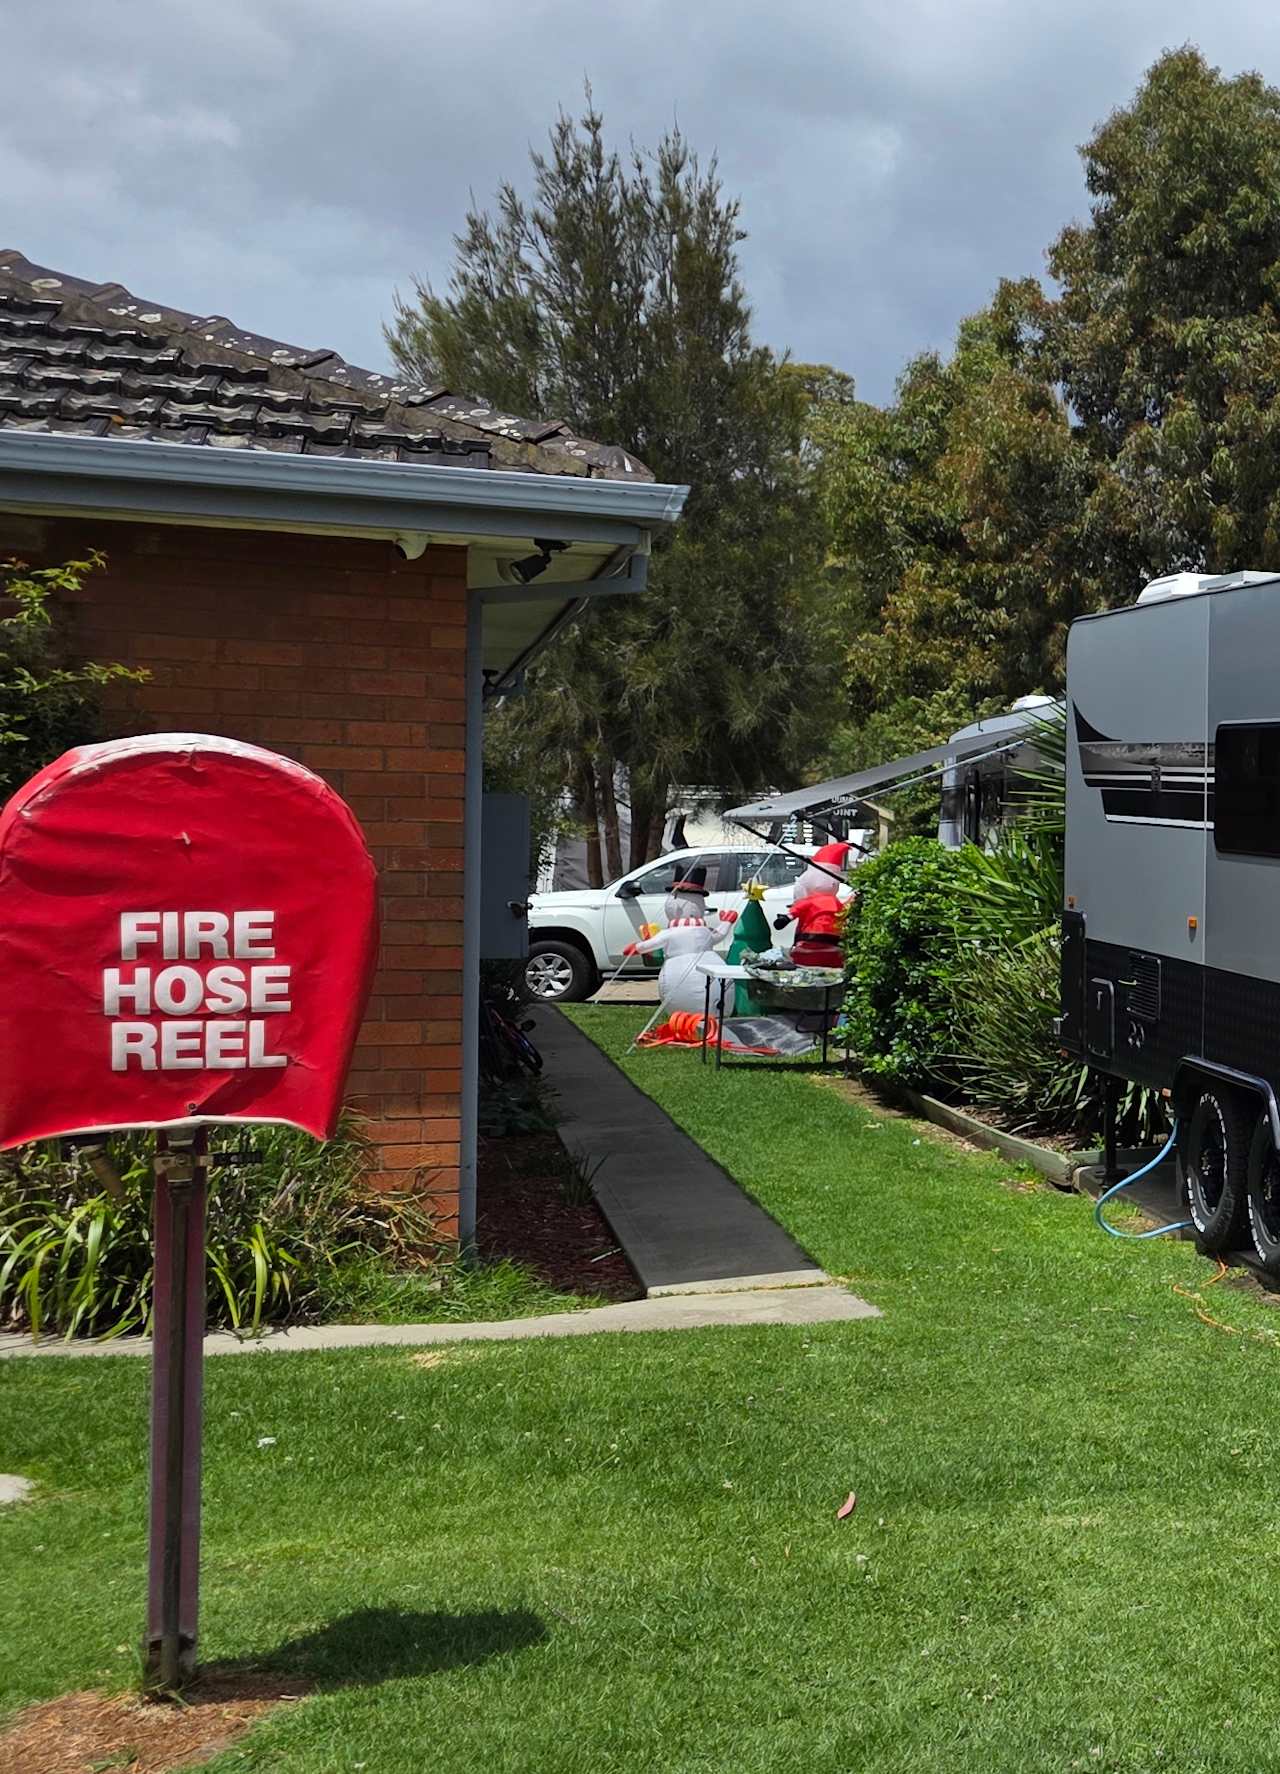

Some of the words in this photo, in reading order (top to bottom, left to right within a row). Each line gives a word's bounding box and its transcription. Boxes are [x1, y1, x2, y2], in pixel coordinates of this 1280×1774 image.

[119, 910, 276, 961] FIRE
[102, 964, 293, 1017] HOSE
[110, 1019, 289, 1073] REEL
